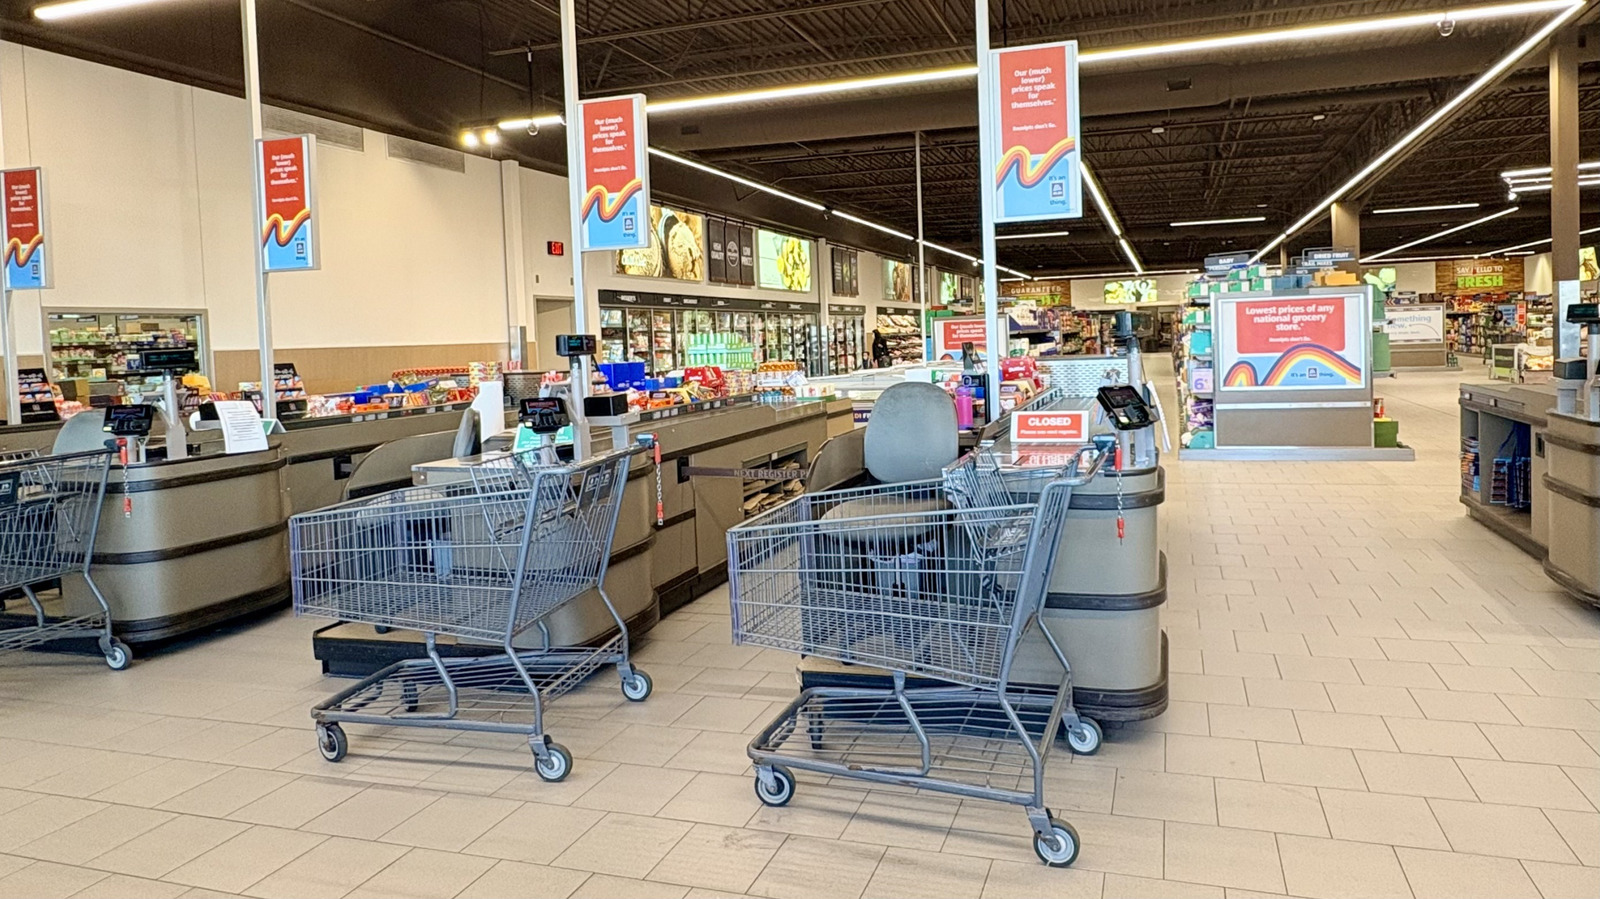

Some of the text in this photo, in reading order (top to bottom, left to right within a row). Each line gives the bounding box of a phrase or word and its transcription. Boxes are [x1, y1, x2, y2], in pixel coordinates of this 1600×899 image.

[1014, 66, 1052, 78] Our (much
[1020, 76, 1046, 85] lower)
[1011, 83, 1056, 95] prices speak
[1027, 92, 1039, 100] for
[594, 116, 624, 126] Our (much
[599, 124, 618, 132] lower)
[592, 130, 626, 141] prices speak
[1049, 199, 1067, 207] thing.
[1457, 275, 1504, 288] FRESH
[1011, 285, 1062, 295] GUARANTEED
[1246, 304, 1335, 315] Lowest prices of any
[1253, 314, 1327, 324] national grocery
[1194, 378, 1205, 390] 6
[1028, 417, 1072, 426] CLOSED
[733, 469, 755, 478] NEXT
[757, 469, 798, 479] REGISTER
